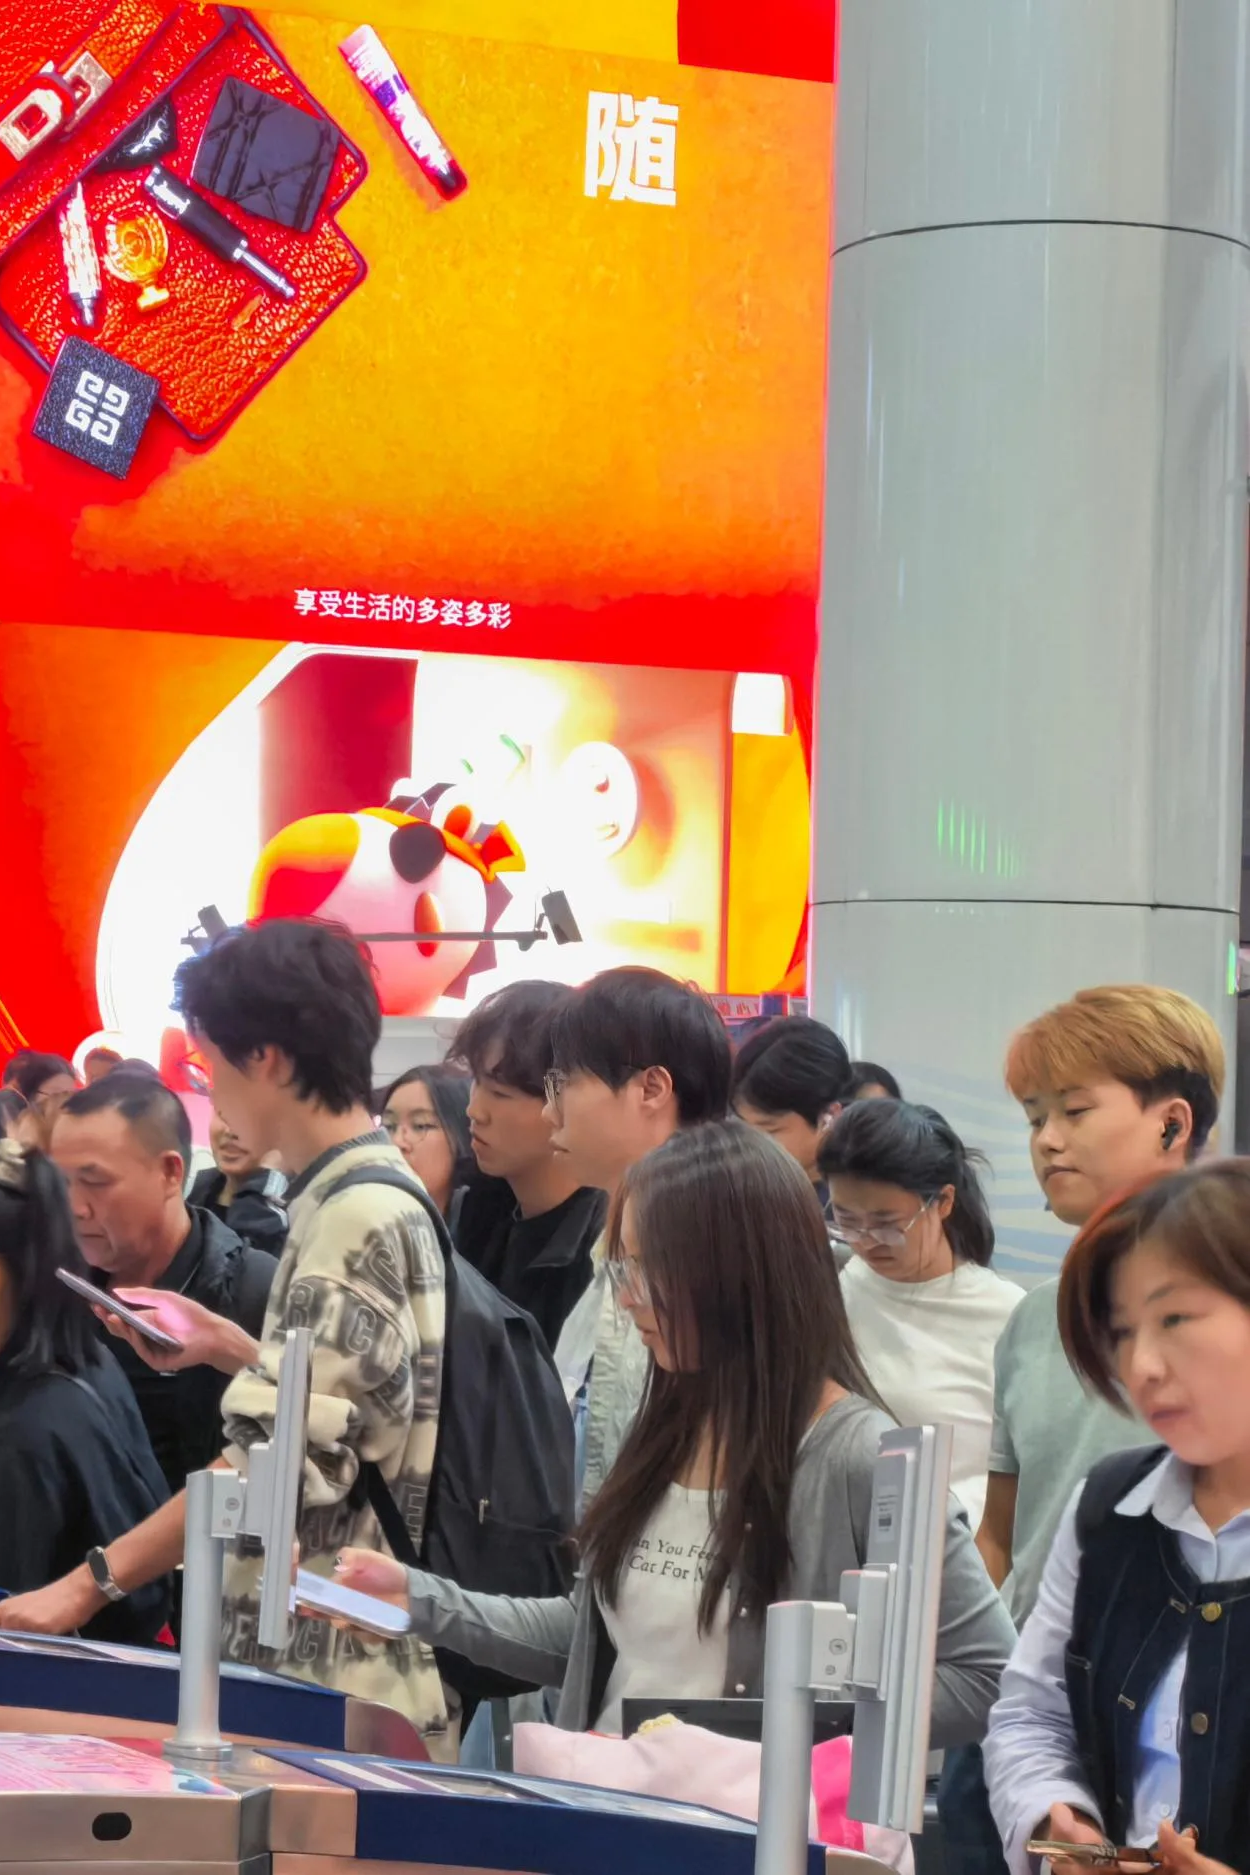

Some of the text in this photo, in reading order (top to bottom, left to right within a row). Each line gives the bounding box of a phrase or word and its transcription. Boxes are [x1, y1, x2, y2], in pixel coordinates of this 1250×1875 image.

[584, 90, 678, 206] 随
[294, 588, 511, 629] 享受生活的多姿多彩
[632, 1539, 650, 1550] an
[658, 1539, 684, 1556] You
[630, 1555, 657, 1573] Cat
[661, 1560, 690, 1580] For
